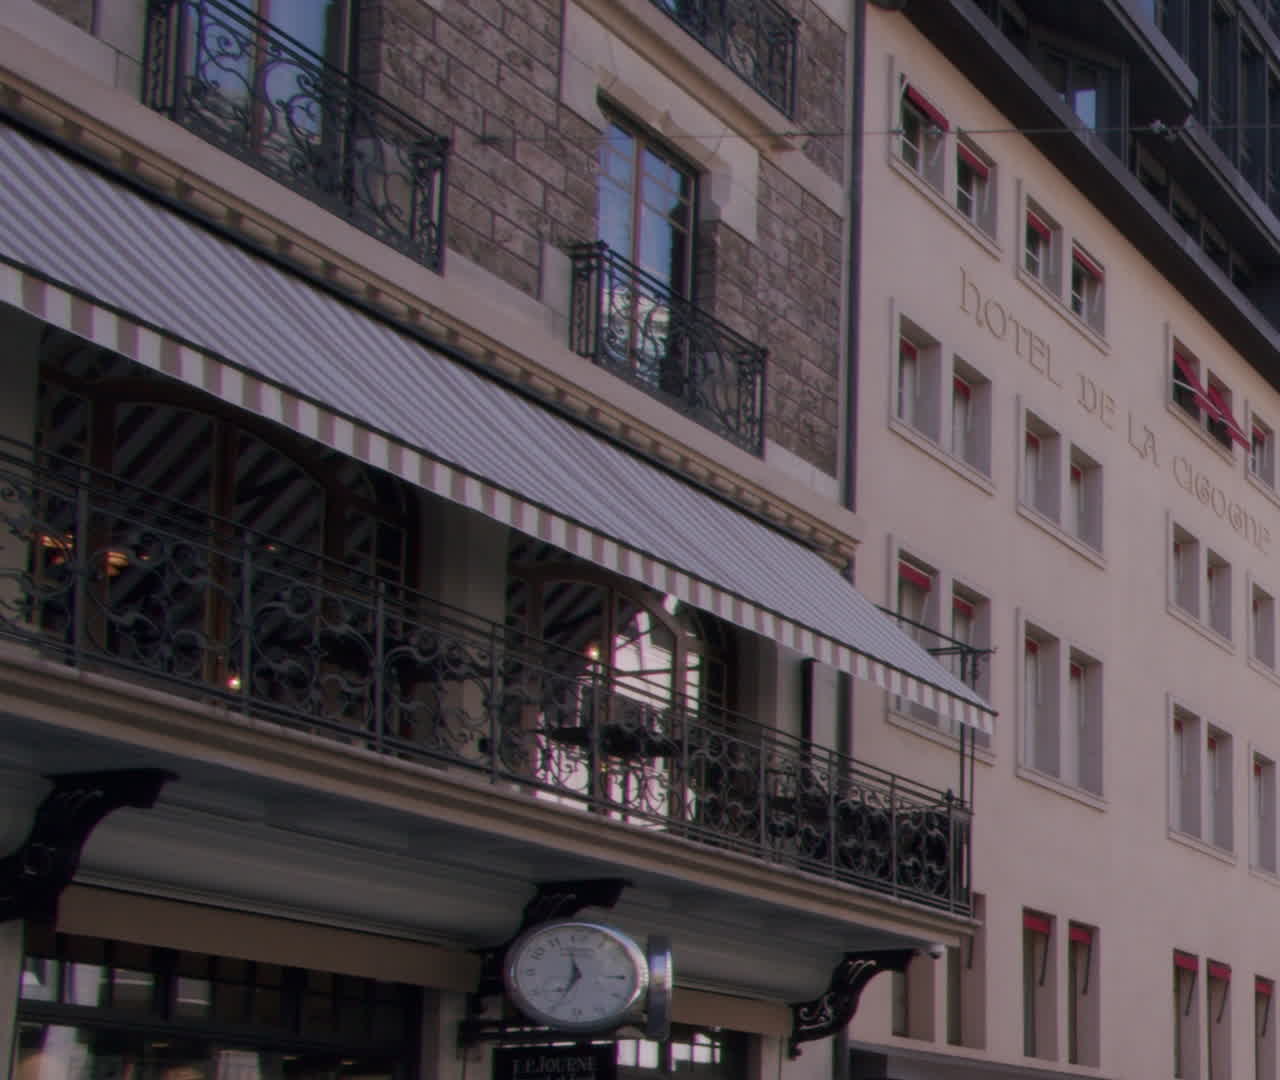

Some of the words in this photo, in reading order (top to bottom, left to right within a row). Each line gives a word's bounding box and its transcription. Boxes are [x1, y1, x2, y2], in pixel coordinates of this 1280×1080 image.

[1076, 371, 1116, 430] DE
[1127, 411, 1161, 469] LA
[1172, 455, 1272, 552] CIGOGNE
